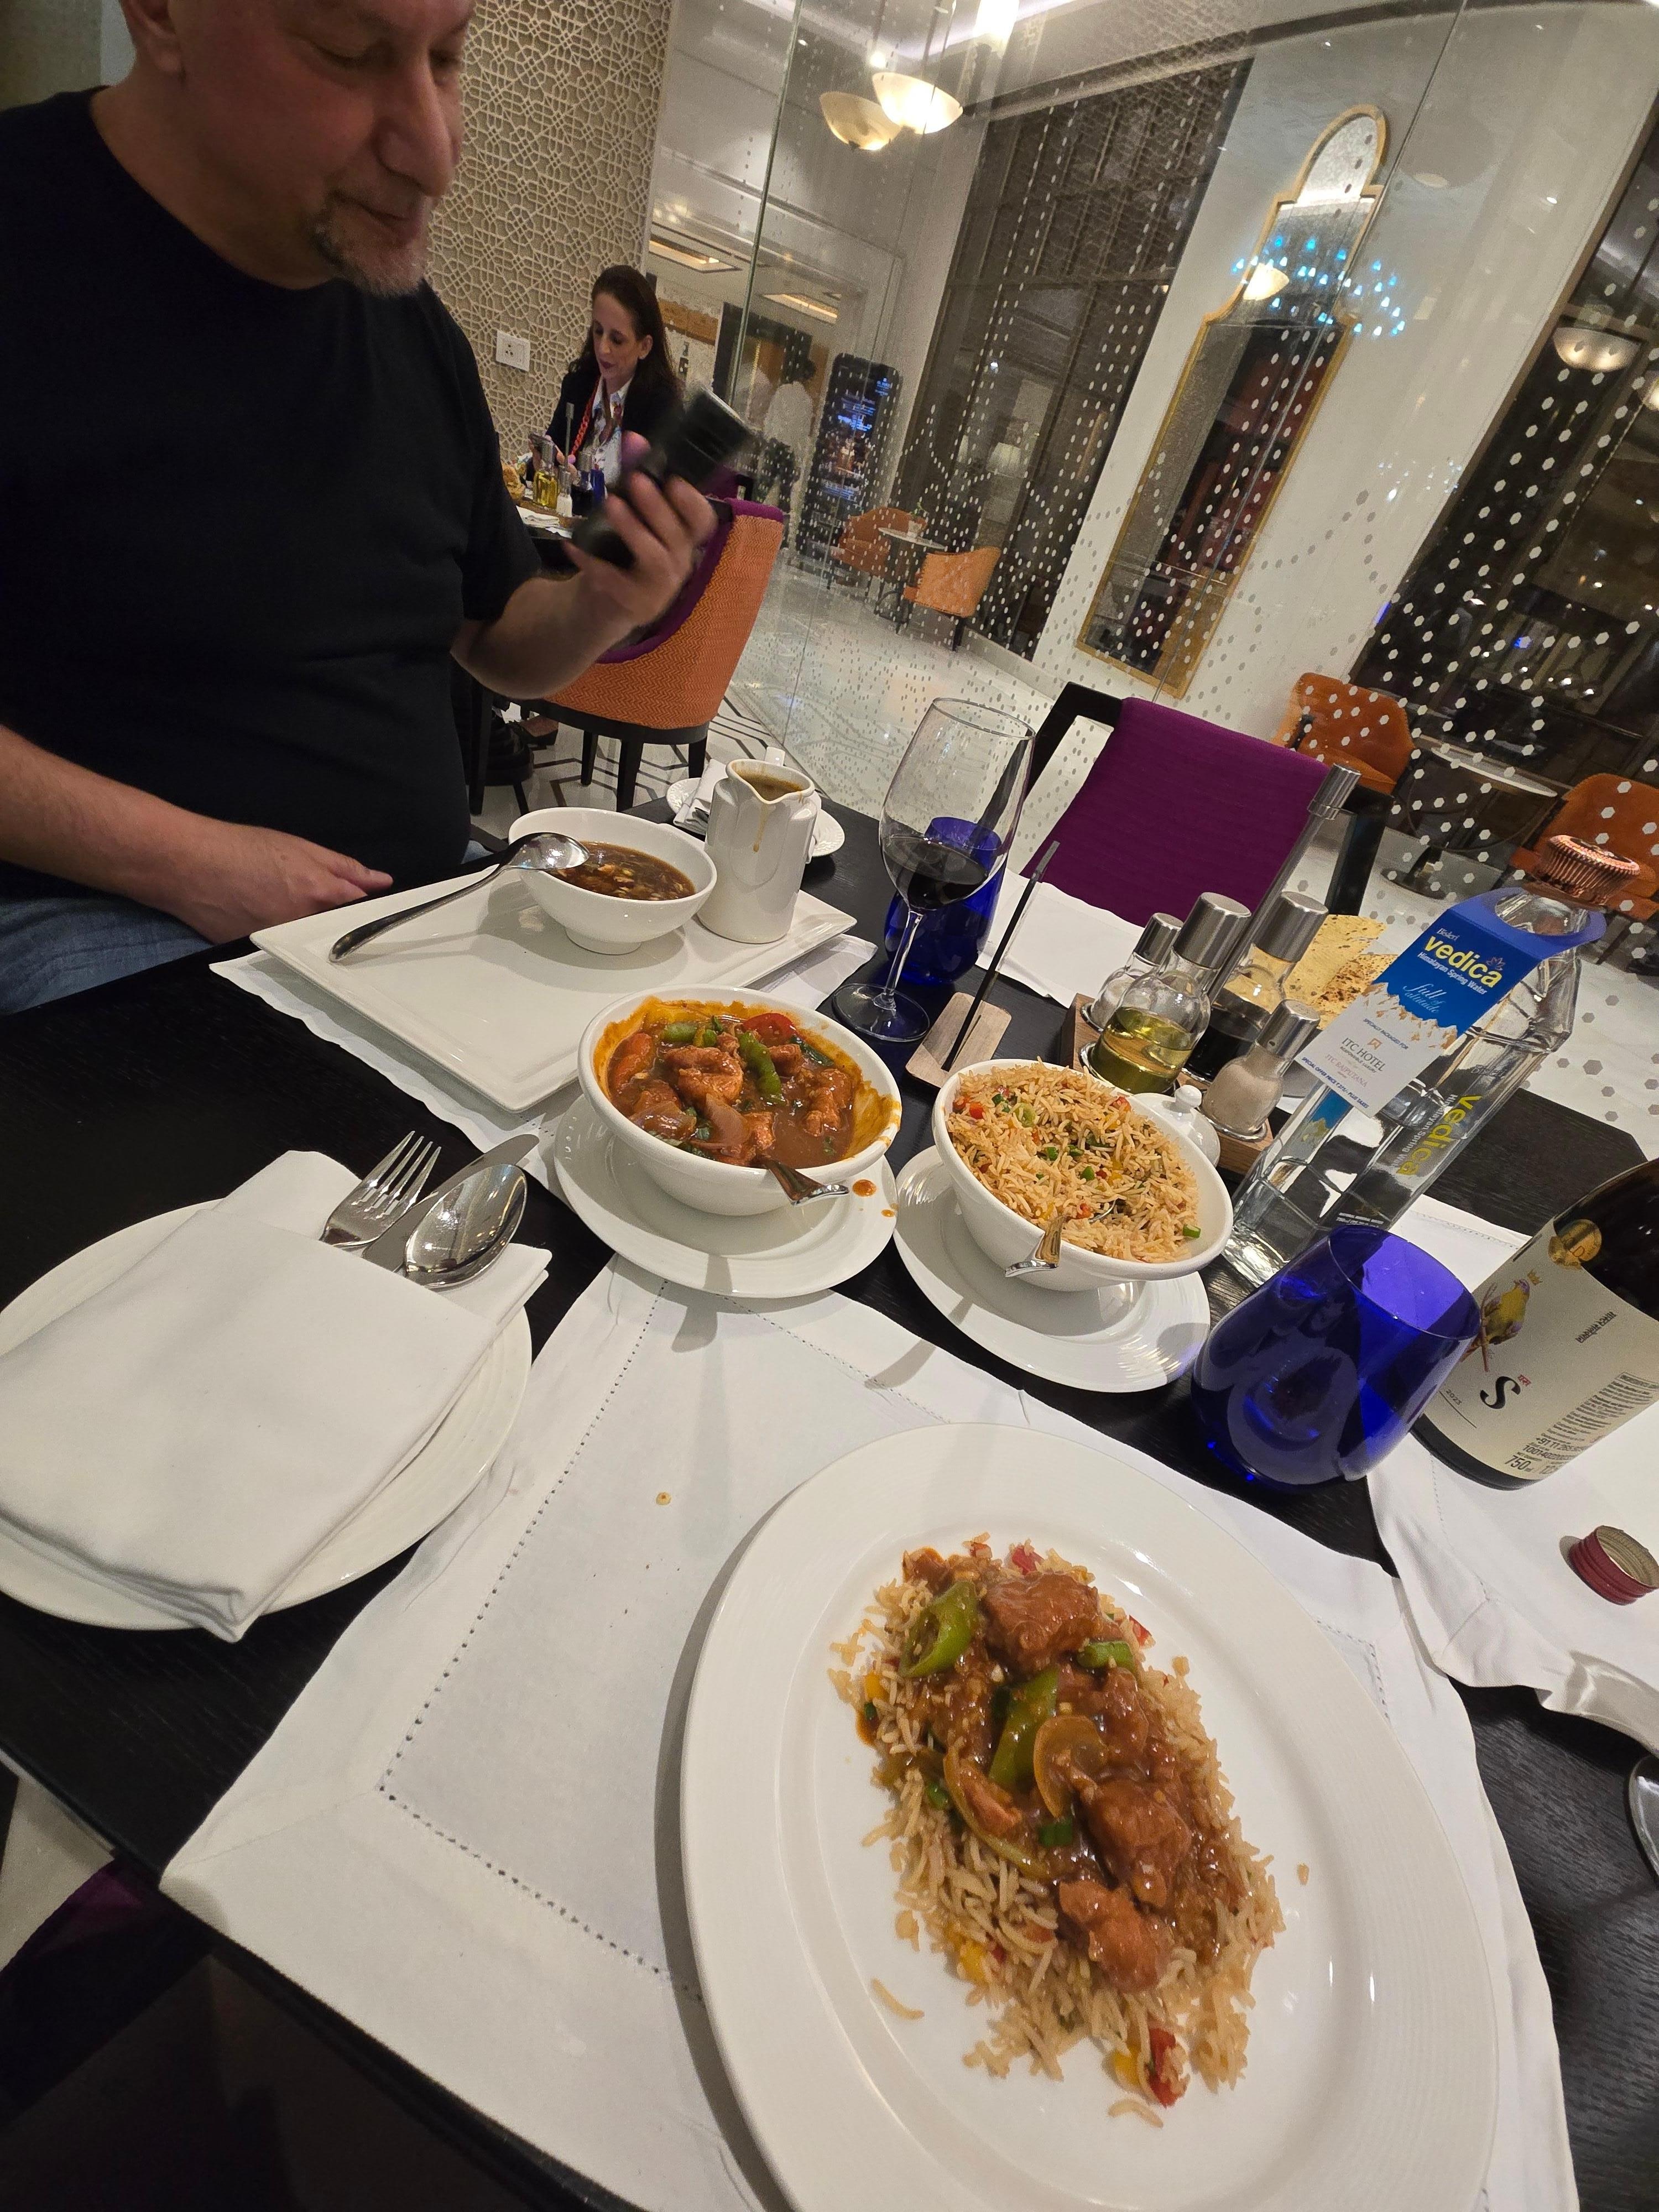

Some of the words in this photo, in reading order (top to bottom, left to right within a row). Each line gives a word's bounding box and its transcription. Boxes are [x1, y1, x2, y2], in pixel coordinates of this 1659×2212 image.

[1417, 952, 1448, 972] Himalayan
[1447, 969, 1468, 985] Spring
[1467, 980, 1488, 995] Water
[1425, 936, 1503, 988] vedica
[1402, 983, 1447, 999] full
[1342, 1037, 1359, 1051] ITC
[1357, 1048, 1386, 1072] HOTEL
[1302, 1057, 1315, 1068] SPECIAL
[1315, 1067, 1327, 1076] OFFER
[1326, 1074, 1337, 1084] PRICE
[1348, 1092, 1358, 1100] PLUS
[1357, 1098, 1370, 1109] TAXES
[1396, 1095, 1483, 1175] vedica
[1402, 1131, 1426, 1152] Spring
[1480, 1376, 1521, 1409] S
